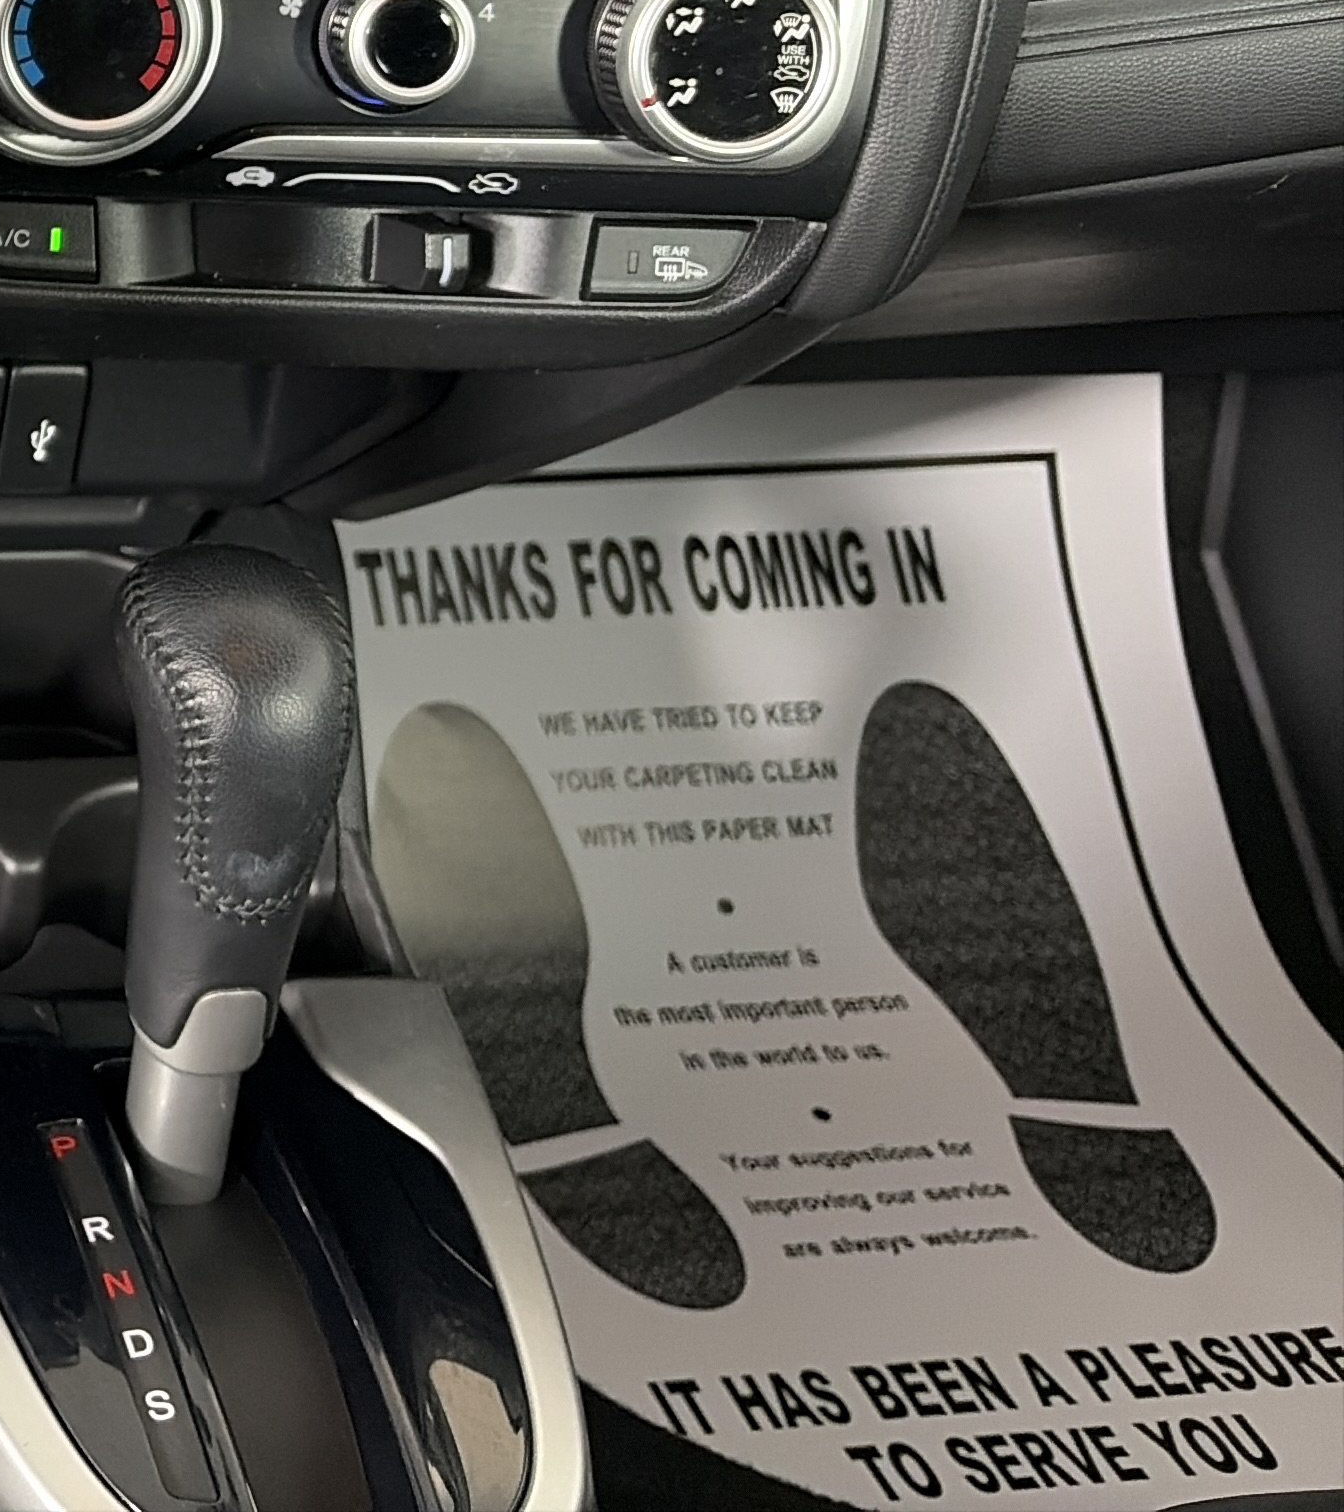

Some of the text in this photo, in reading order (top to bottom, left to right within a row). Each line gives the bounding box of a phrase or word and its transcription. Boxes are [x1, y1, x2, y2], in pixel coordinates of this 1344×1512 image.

[477, 1, 496, 22] 4
[776, 54, 810, 66] WITH
[781, 44, 807, 55] USE
[652, 244, 691, 257] REAR
[352, 525, 947, 628] THANKS FOR COMING IN
[538, 699, 824, 738] WE HAVE TRIED TO KEEP
[549, 758, 838, 793] YOUR CARPETING CLEAN
[576, 813, 833, 849] WITH THIS PAPER MAT
[667, 946, 820, 976] A customer is
[613, 992, 909, 1027] the most important person
[679, 1041, 890, 1071] in the world to us.
[49, 1135, 77, 1160] P
[720, 1138, 974, 1173] Your suggestions for
[743, 1180, 1010, 1217] improving our service
[81, 1215, 115, 1243] R
[782, 1225, 1038, 1259] are always welcome.
[101, 1269, 136, 1300] N
[121, 1328, 155, 1359] D
[647, 1326, 1344, 1437] IT HAS BEEN A PLEASURE
[144, 1389, 177, 1422] S
[844, 1413, 1280, 1503] TO SERVE YOU
